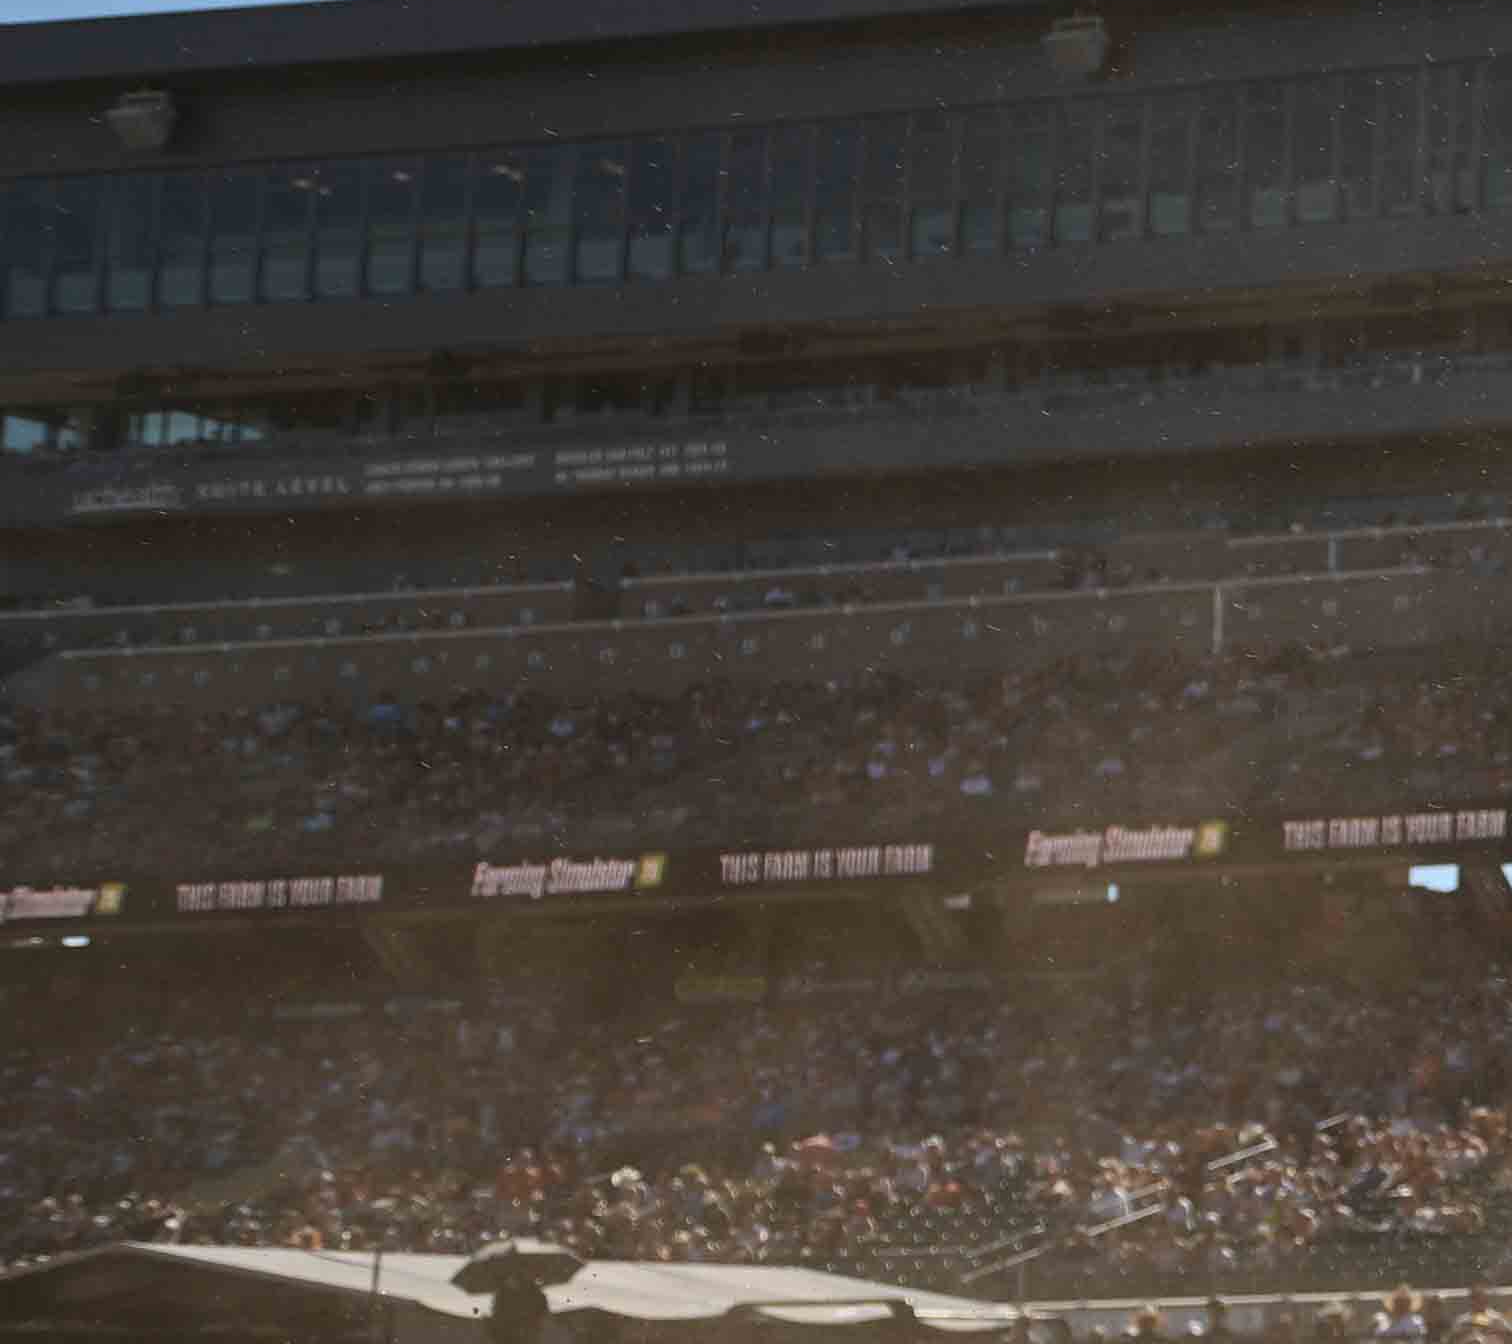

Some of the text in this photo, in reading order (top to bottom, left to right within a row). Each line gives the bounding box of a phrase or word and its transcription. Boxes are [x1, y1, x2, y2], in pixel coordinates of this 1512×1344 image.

[1025, 829, 1103, 868] Farming
[1104, 824, 1195, 864] Simulator
[1282, 810, 1508, 851] THIS FARM IS YOUR FARM
[471, 860, 546, 899] Farming
[547, 857, 636, 895] Simulator
[720, 844, 933, 884] THIS FARM IS YOUR FARM
